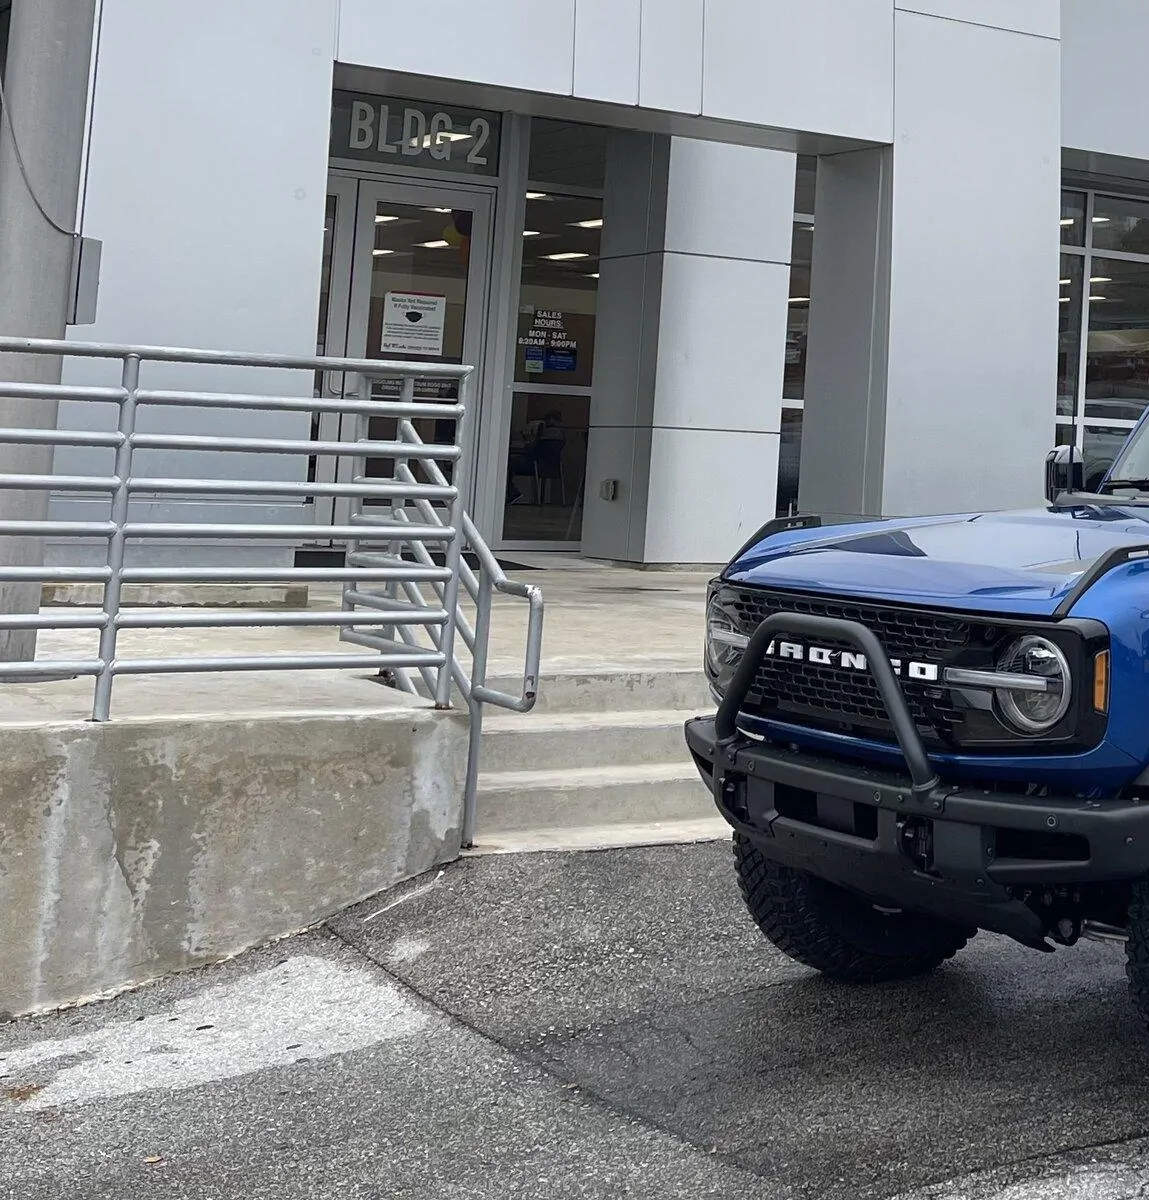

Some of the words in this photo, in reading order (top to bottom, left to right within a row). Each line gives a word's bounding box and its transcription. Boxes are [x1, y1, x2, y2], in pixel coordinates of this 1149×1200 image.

[349, 100, 453, 161] BLDG
[466, 117, 490, 165] 2
[537, 311, 562, 319] SALES
[528, 330, 547, 338] MON
[552, 331, 567, 340] SAT
